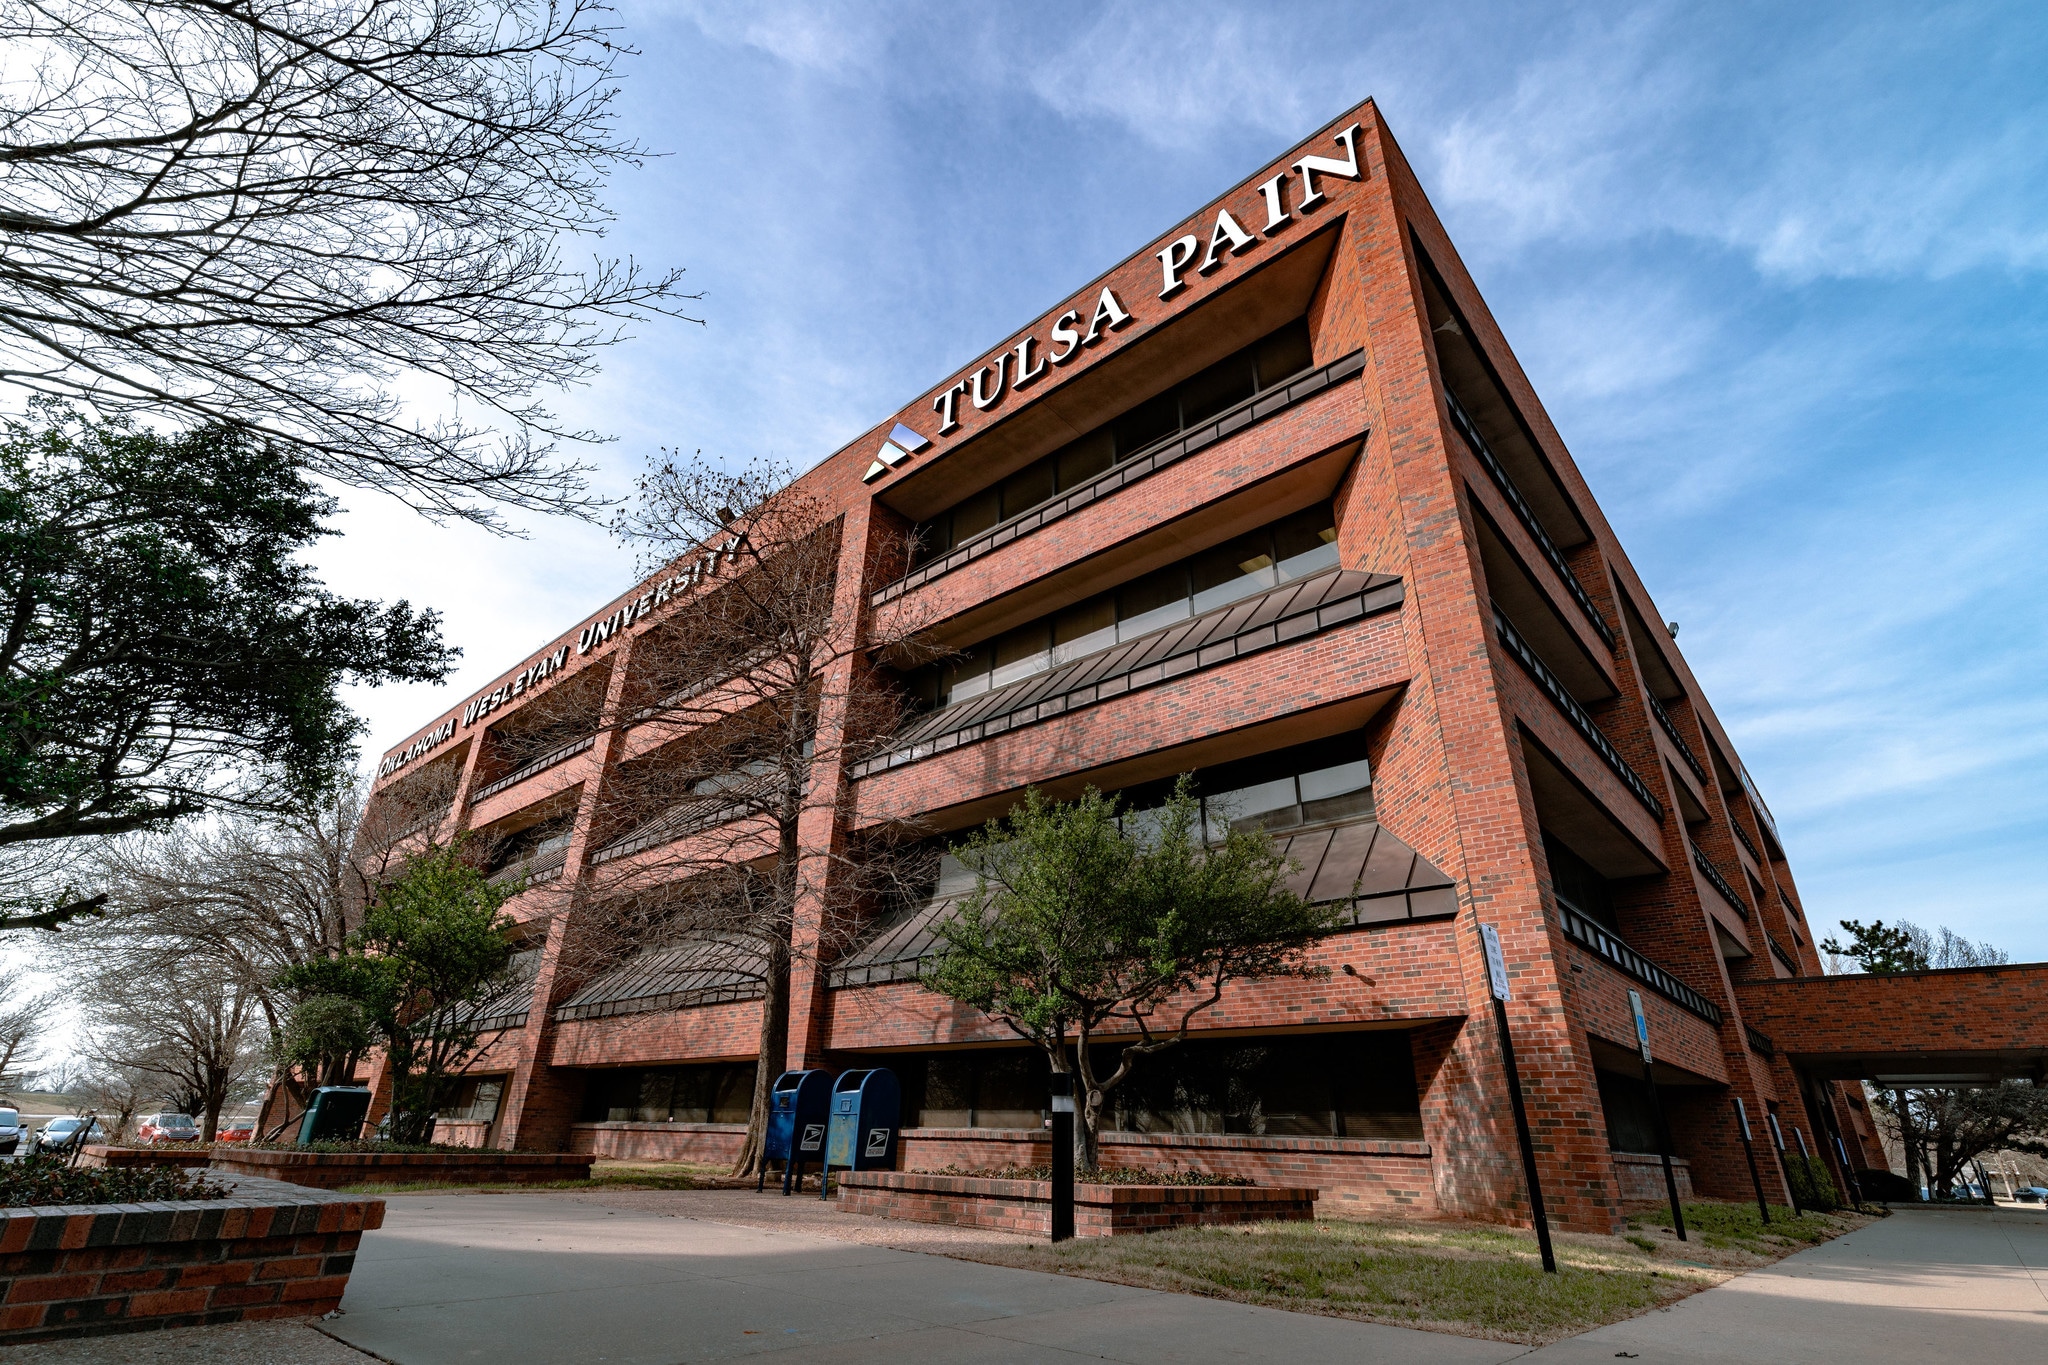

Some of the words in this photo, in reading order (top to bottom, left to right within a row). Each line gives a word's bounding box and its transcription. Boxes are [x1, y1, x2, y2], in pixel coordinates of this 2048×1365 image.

[933, 286, 1131, 436] TULSA
[1156, 122, 1361, 300] PAIN
[378, 718, 457, 779] OKLAHOMA
[461, 645, 570, 728] WESLEYAN
[576, 531, 744, 656] UNIVERSITY
